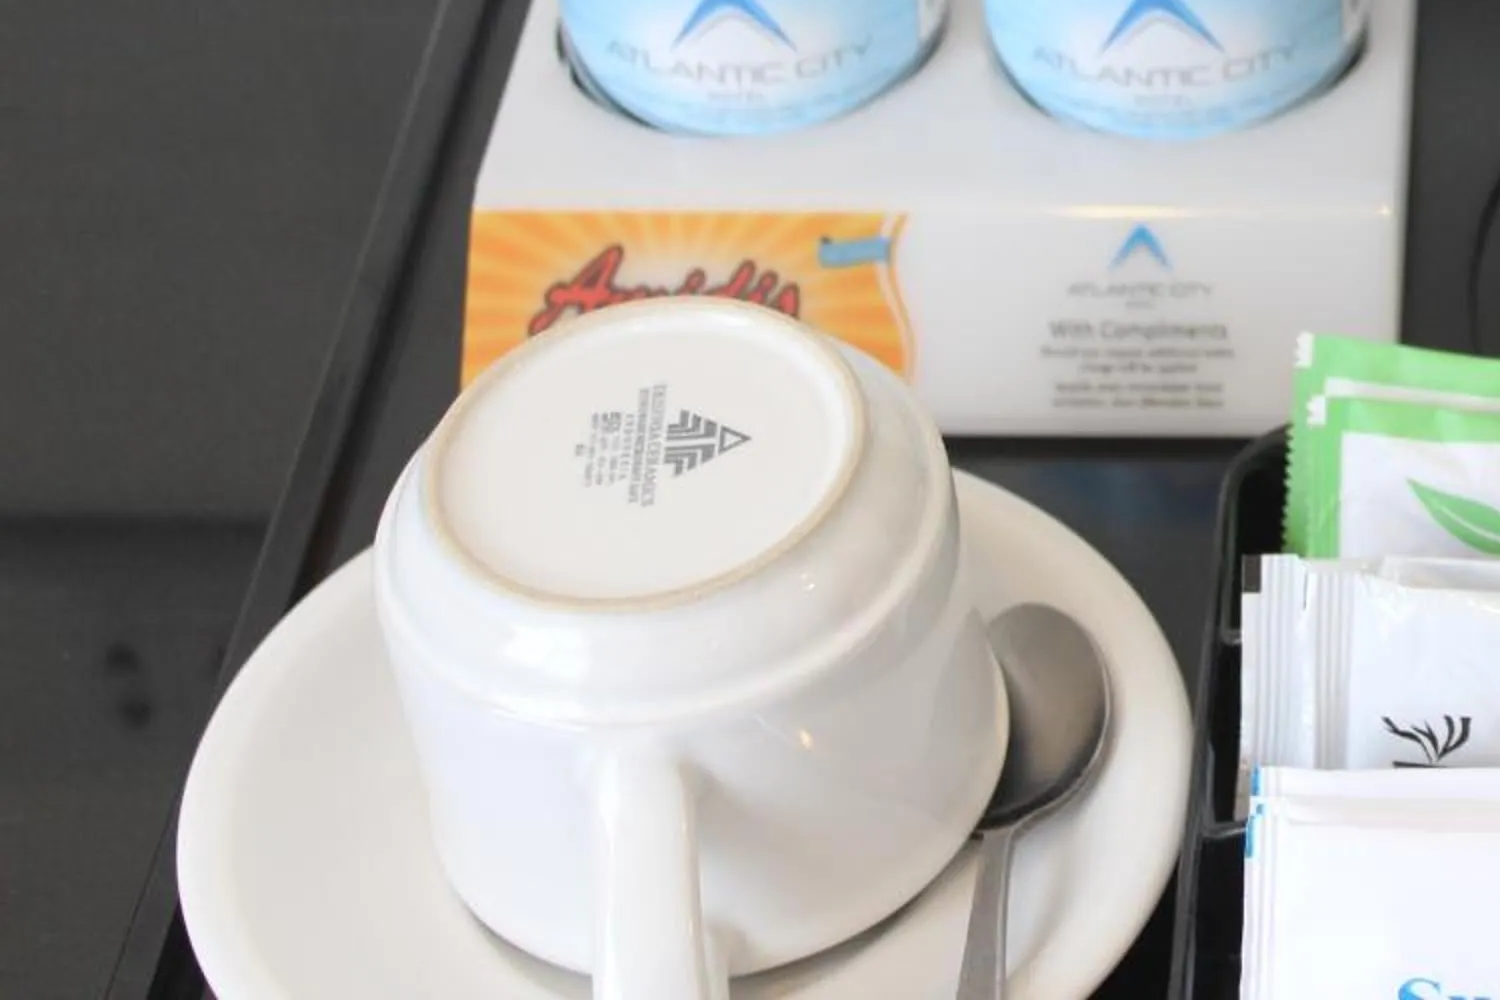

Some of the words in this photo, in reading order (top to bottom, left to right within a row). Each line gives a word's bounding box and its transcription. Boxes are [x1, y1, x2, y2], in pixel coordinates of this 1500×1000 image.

[605, 40, 785, 83] ATLANTIC
[795, 34, 873, 78] CITY
[1032, 46, 1210, 87] ATLANTIC
[1221, 41, 1296, 81] CITY
